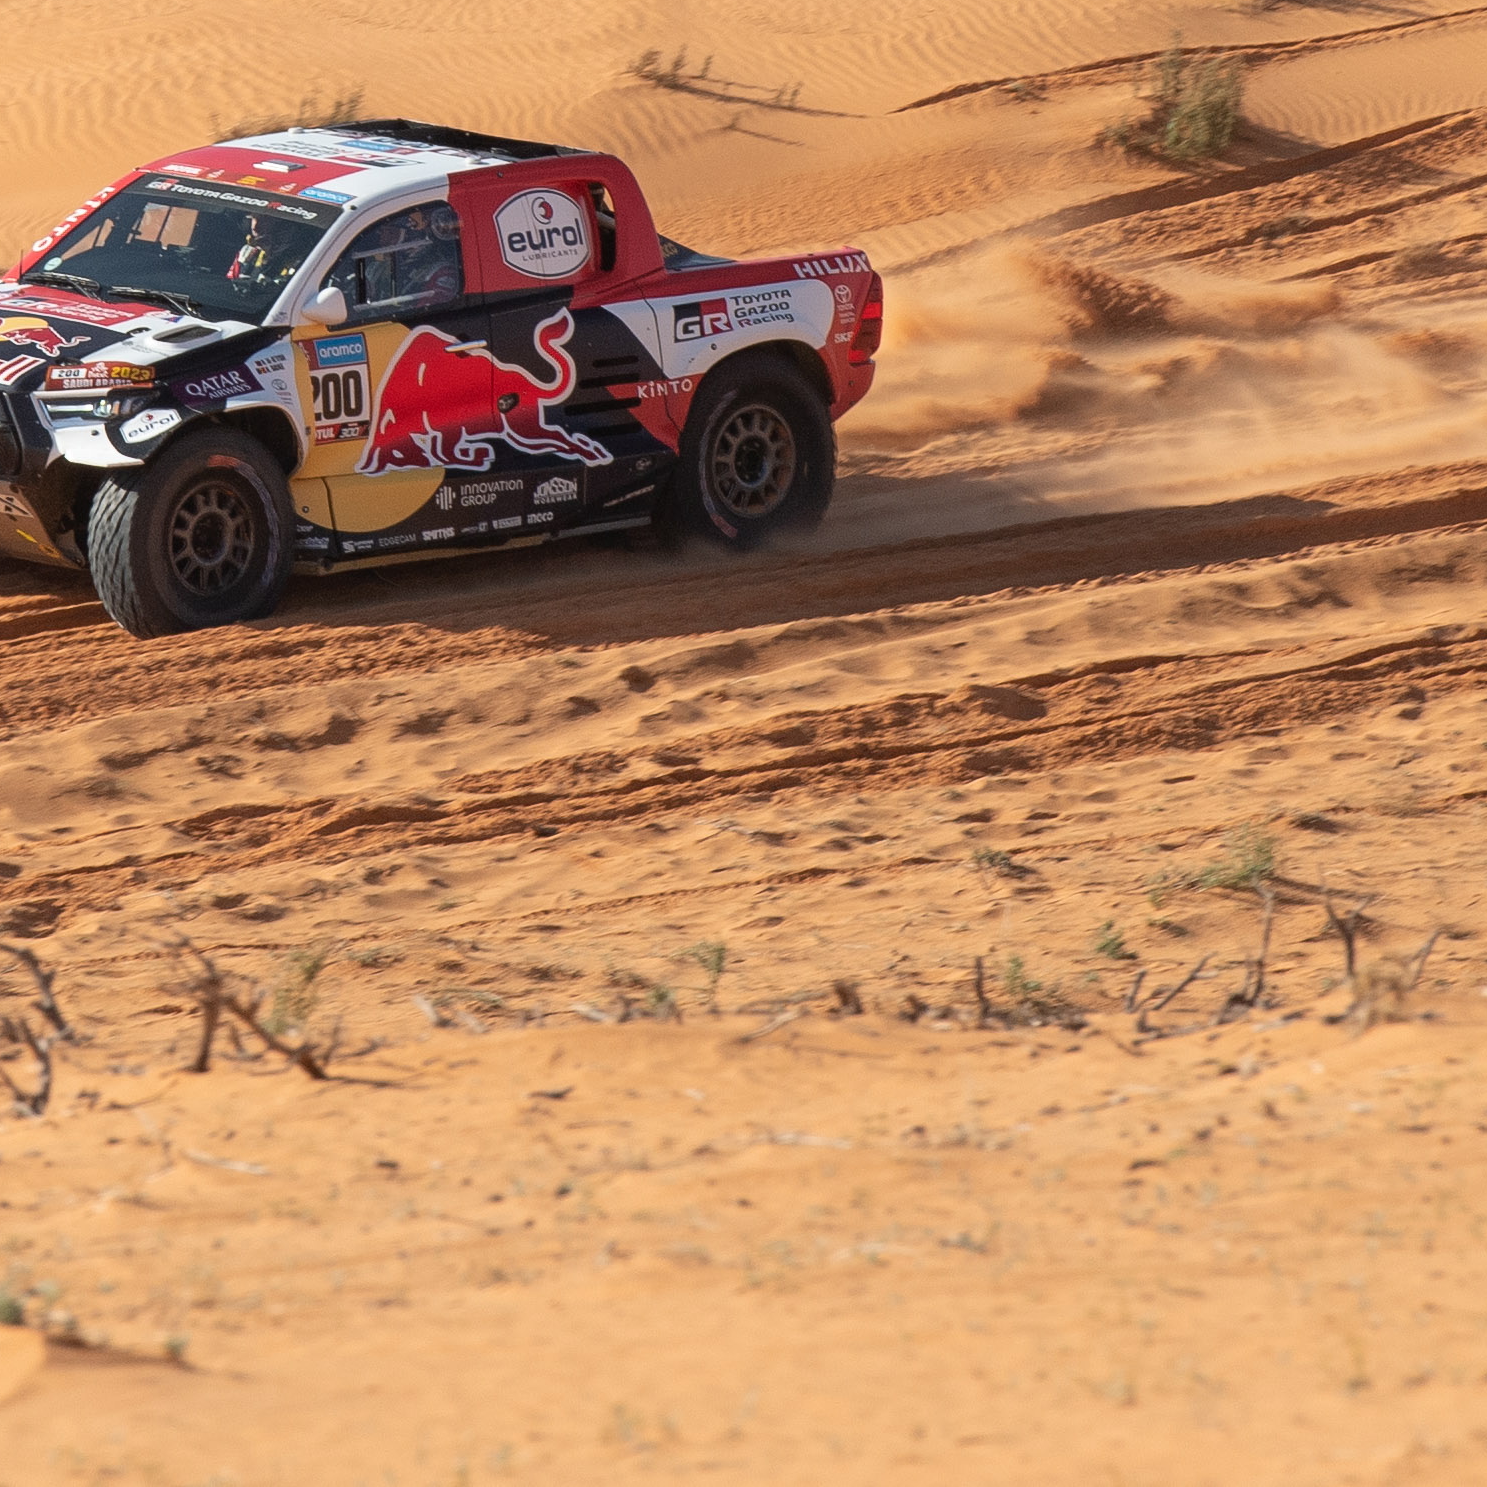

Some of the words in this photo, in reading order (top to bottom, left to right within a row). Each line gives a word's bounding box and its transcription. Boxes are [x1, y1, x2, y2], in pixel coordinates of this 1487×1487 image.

[170, 184, 221, 199] TOYOTA
[267, 201, 318, 220] Racing
[304, 188, 351, 204] aramco
[507, 217, 584, 254] eurol
[521, 248, 579, 262] LUBRICANTS
[792, 253, 872, 279] HILUX
[675, 310, 733, 341] GR
[729, 289, 793, 306] TOYOTA
[733, 300, 791, 319] GAZOO
[737, 312, 796, 329] Racing
[319, 343, 362, 358] aramco
[58, 369, 81, 378] 200
[110, 366, 151, 381] 2023
[62, 378, 94, 389] SAUDI
[185, 370, 245, 397] QATAR
[208, 382, 252, 400] AIRWAYS
[128, 414, 175, 438] eurol
[536, 476, 579, 498] JONSSON
[460, 493, 498, 507] GROUP
[378, 533, 418, 547] EDGECAM
